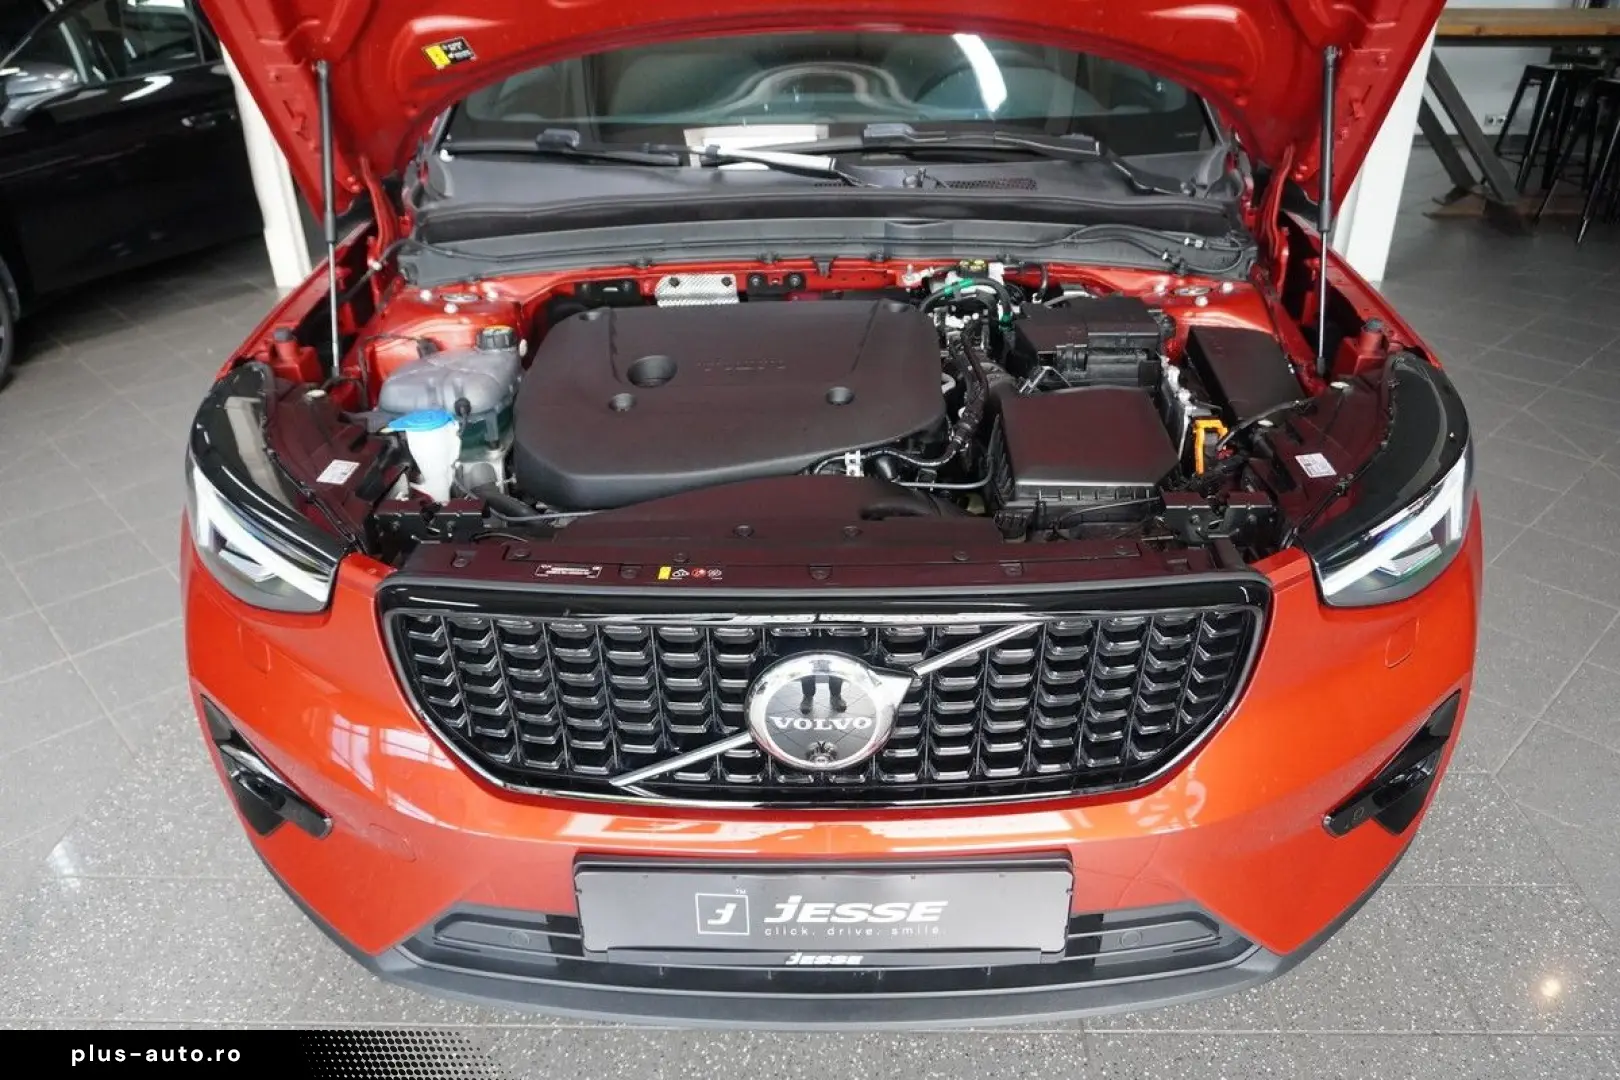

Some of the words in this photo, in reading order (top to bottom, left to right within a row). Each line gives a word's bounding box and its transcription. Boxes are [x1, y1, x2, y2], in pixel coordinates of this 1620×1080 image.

[769, 716, 872, 730] VOLVO
[764, 925, 815, 936] click.
[827, 925, 880, 936] drive.
